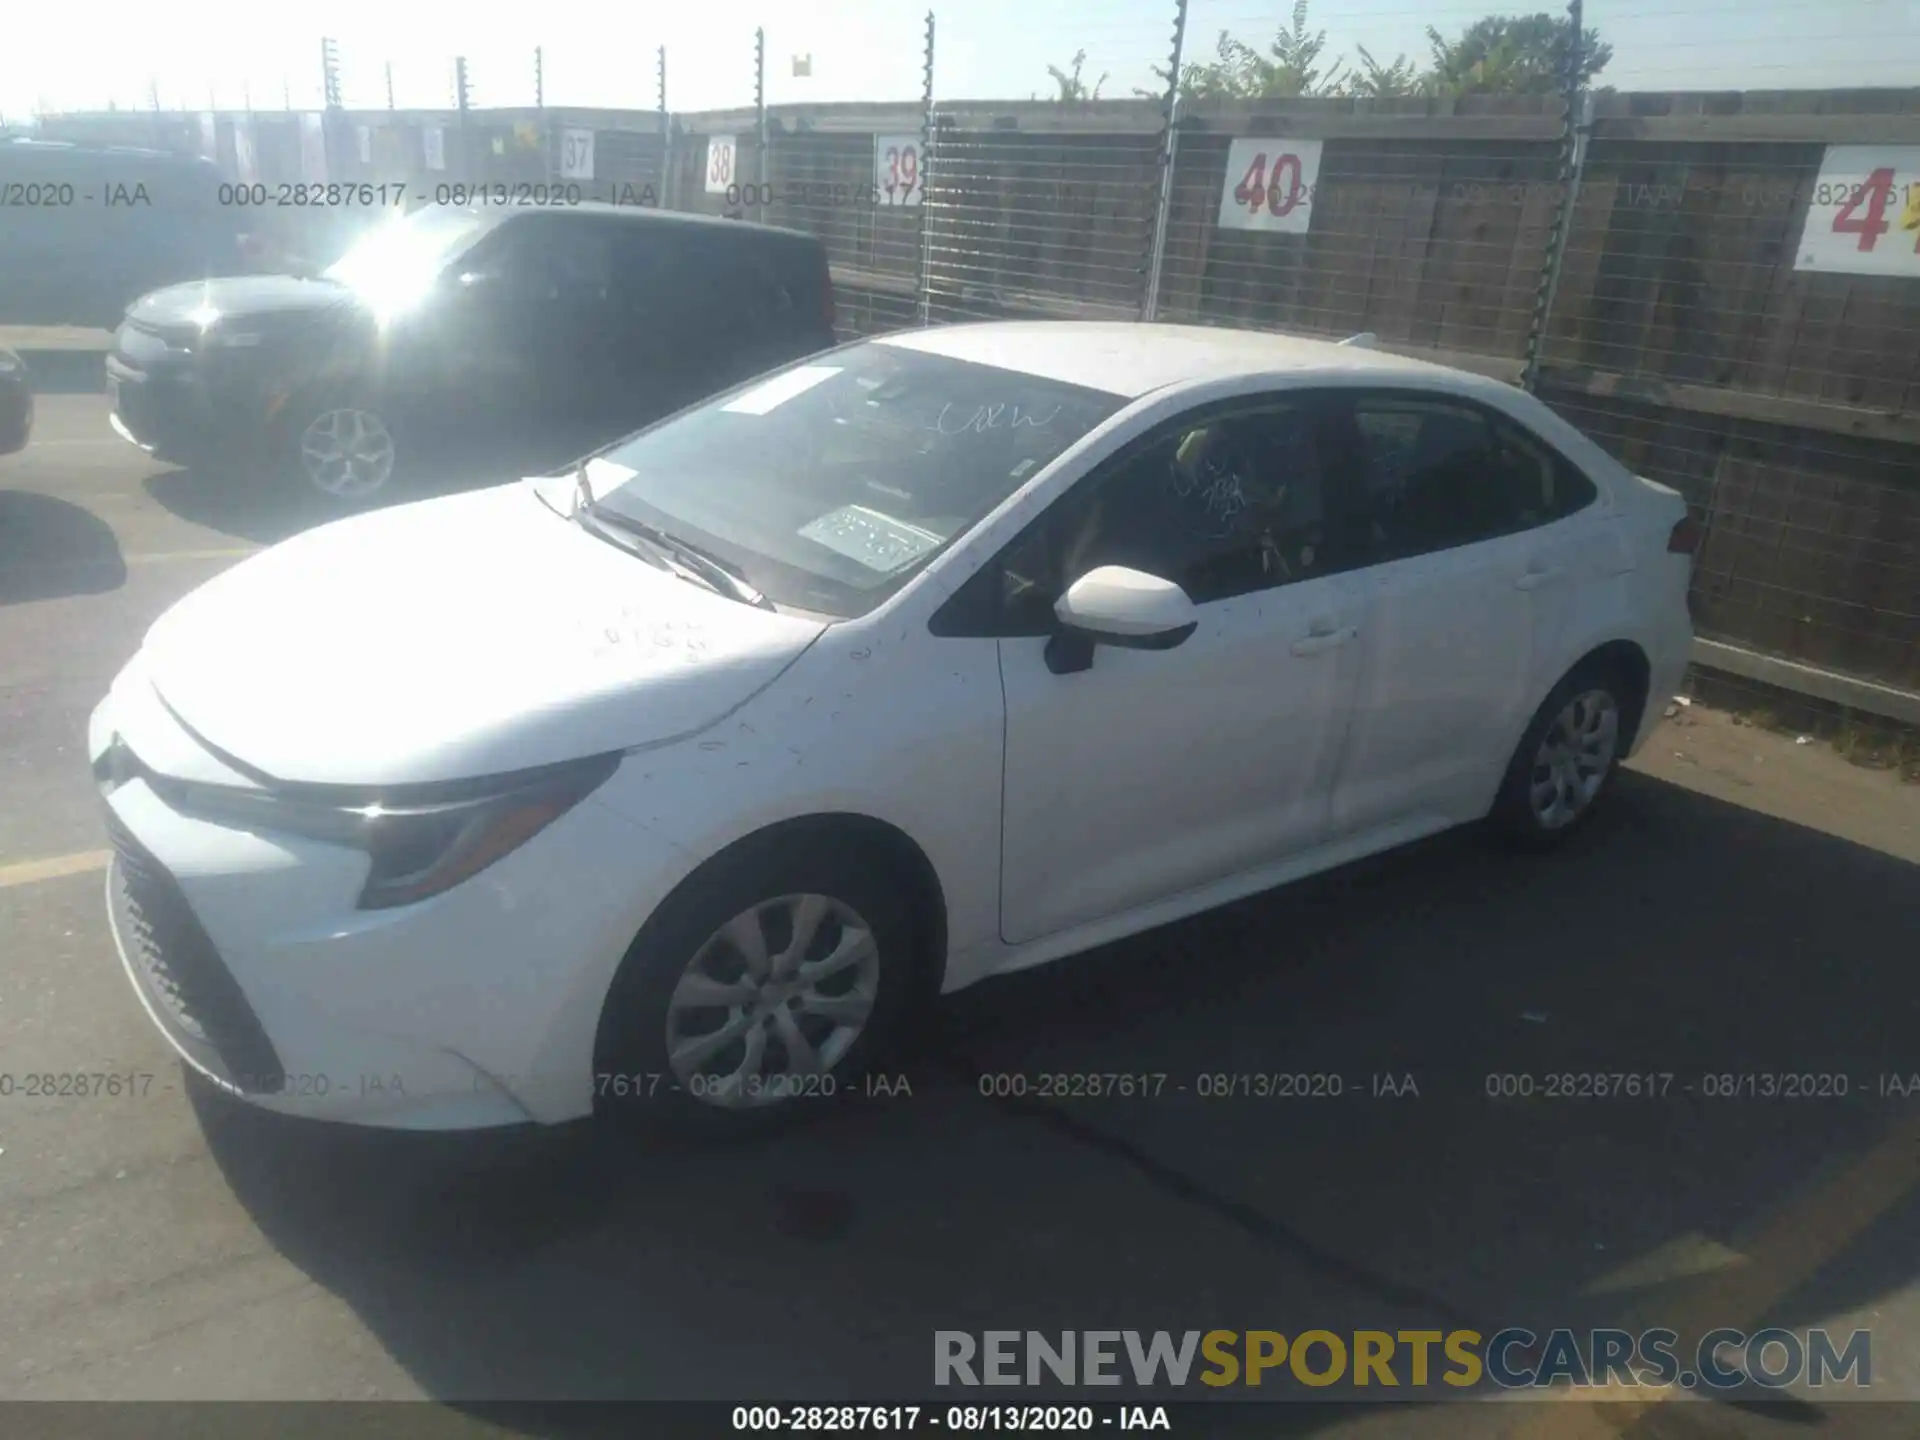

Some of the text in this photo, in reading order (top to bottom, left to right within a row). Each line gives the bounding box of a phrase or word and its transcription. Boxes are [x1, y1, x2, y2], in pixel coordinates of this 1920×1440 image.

[566, 135, 590, 170] 37
[711, 143, 731, 184] 38
[884, 144, 917, 190] 39
[1235, 152, 1302, 216] 40
